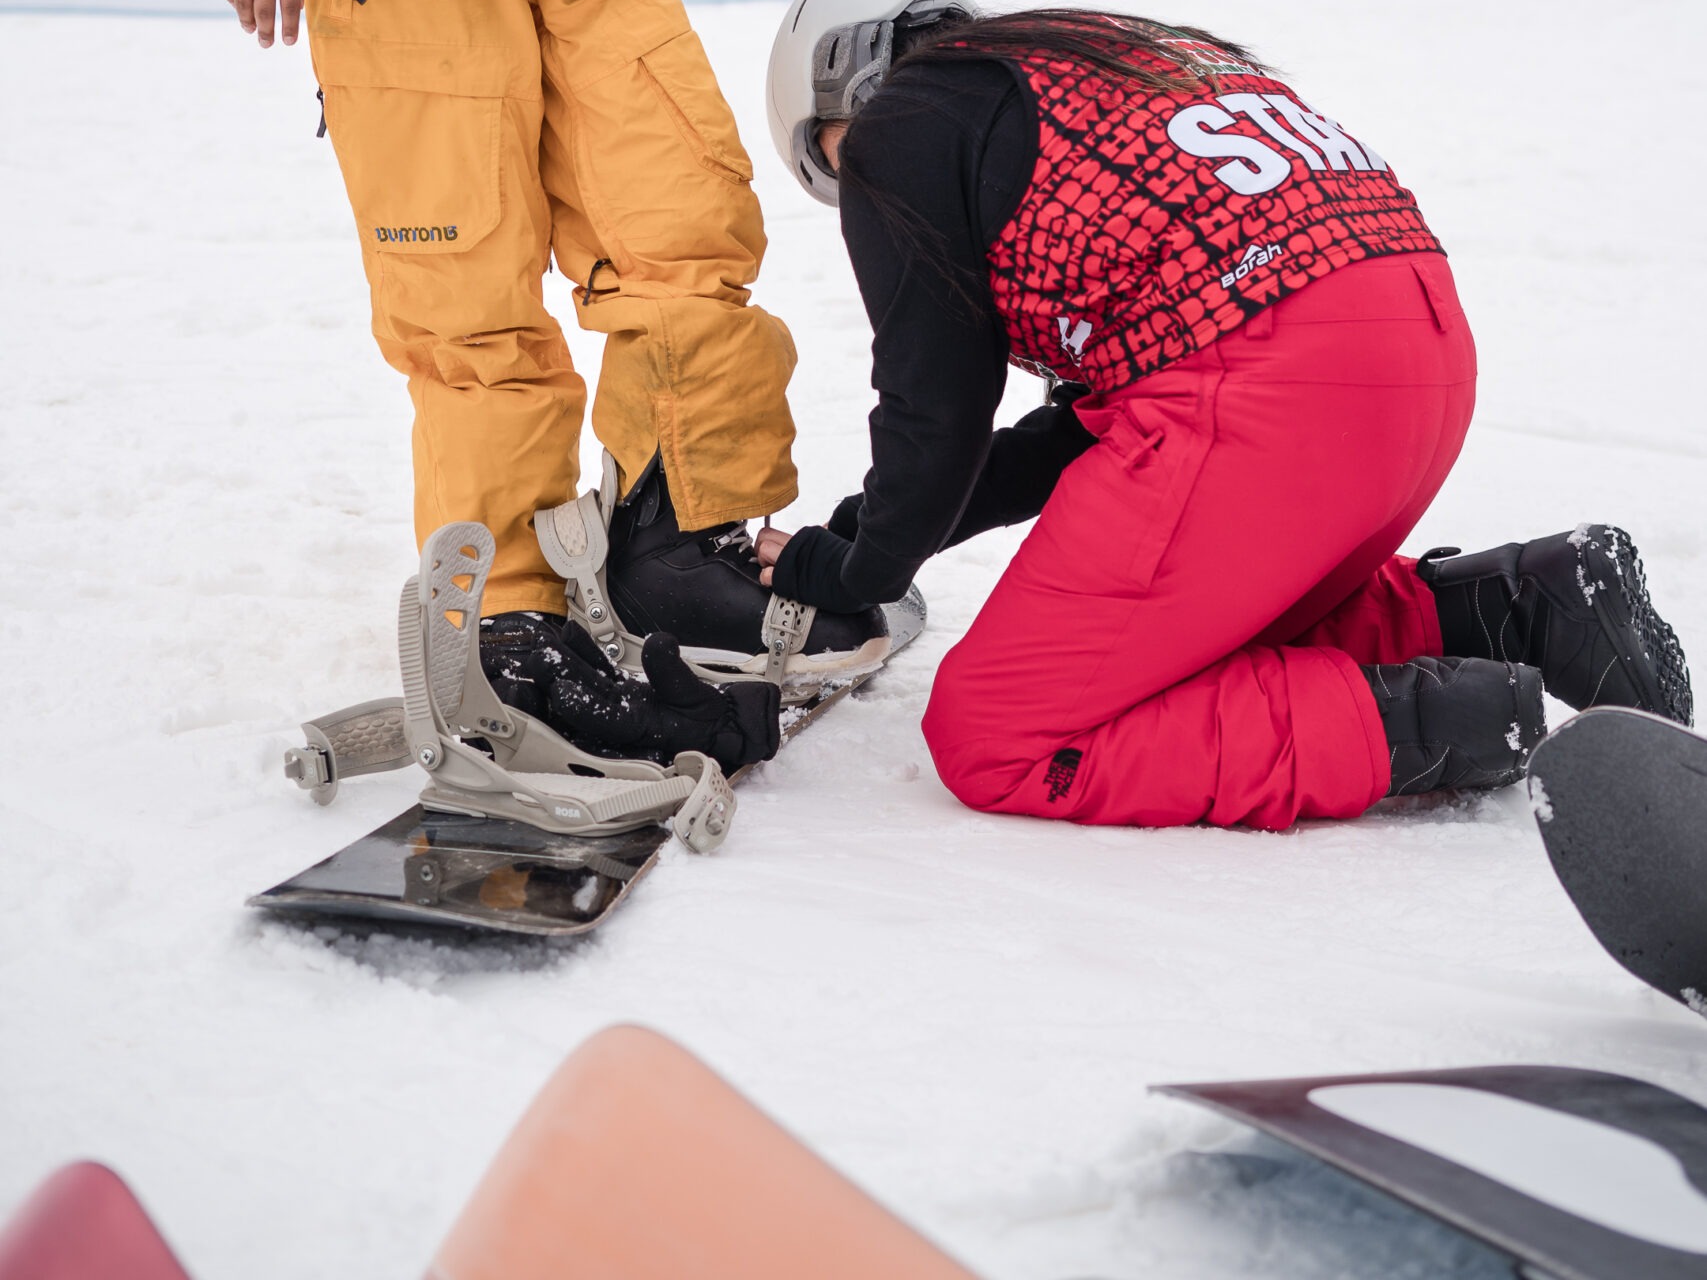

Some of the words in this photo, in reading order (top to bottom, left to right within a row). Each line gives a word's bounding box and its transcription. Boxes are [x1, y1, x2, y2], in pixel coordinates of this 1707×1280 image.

[375, 226, 442, 242] BURTON
[1206, 181, 1324, 252] WOODS
[1241, 239, 1366, 305] WOODS
